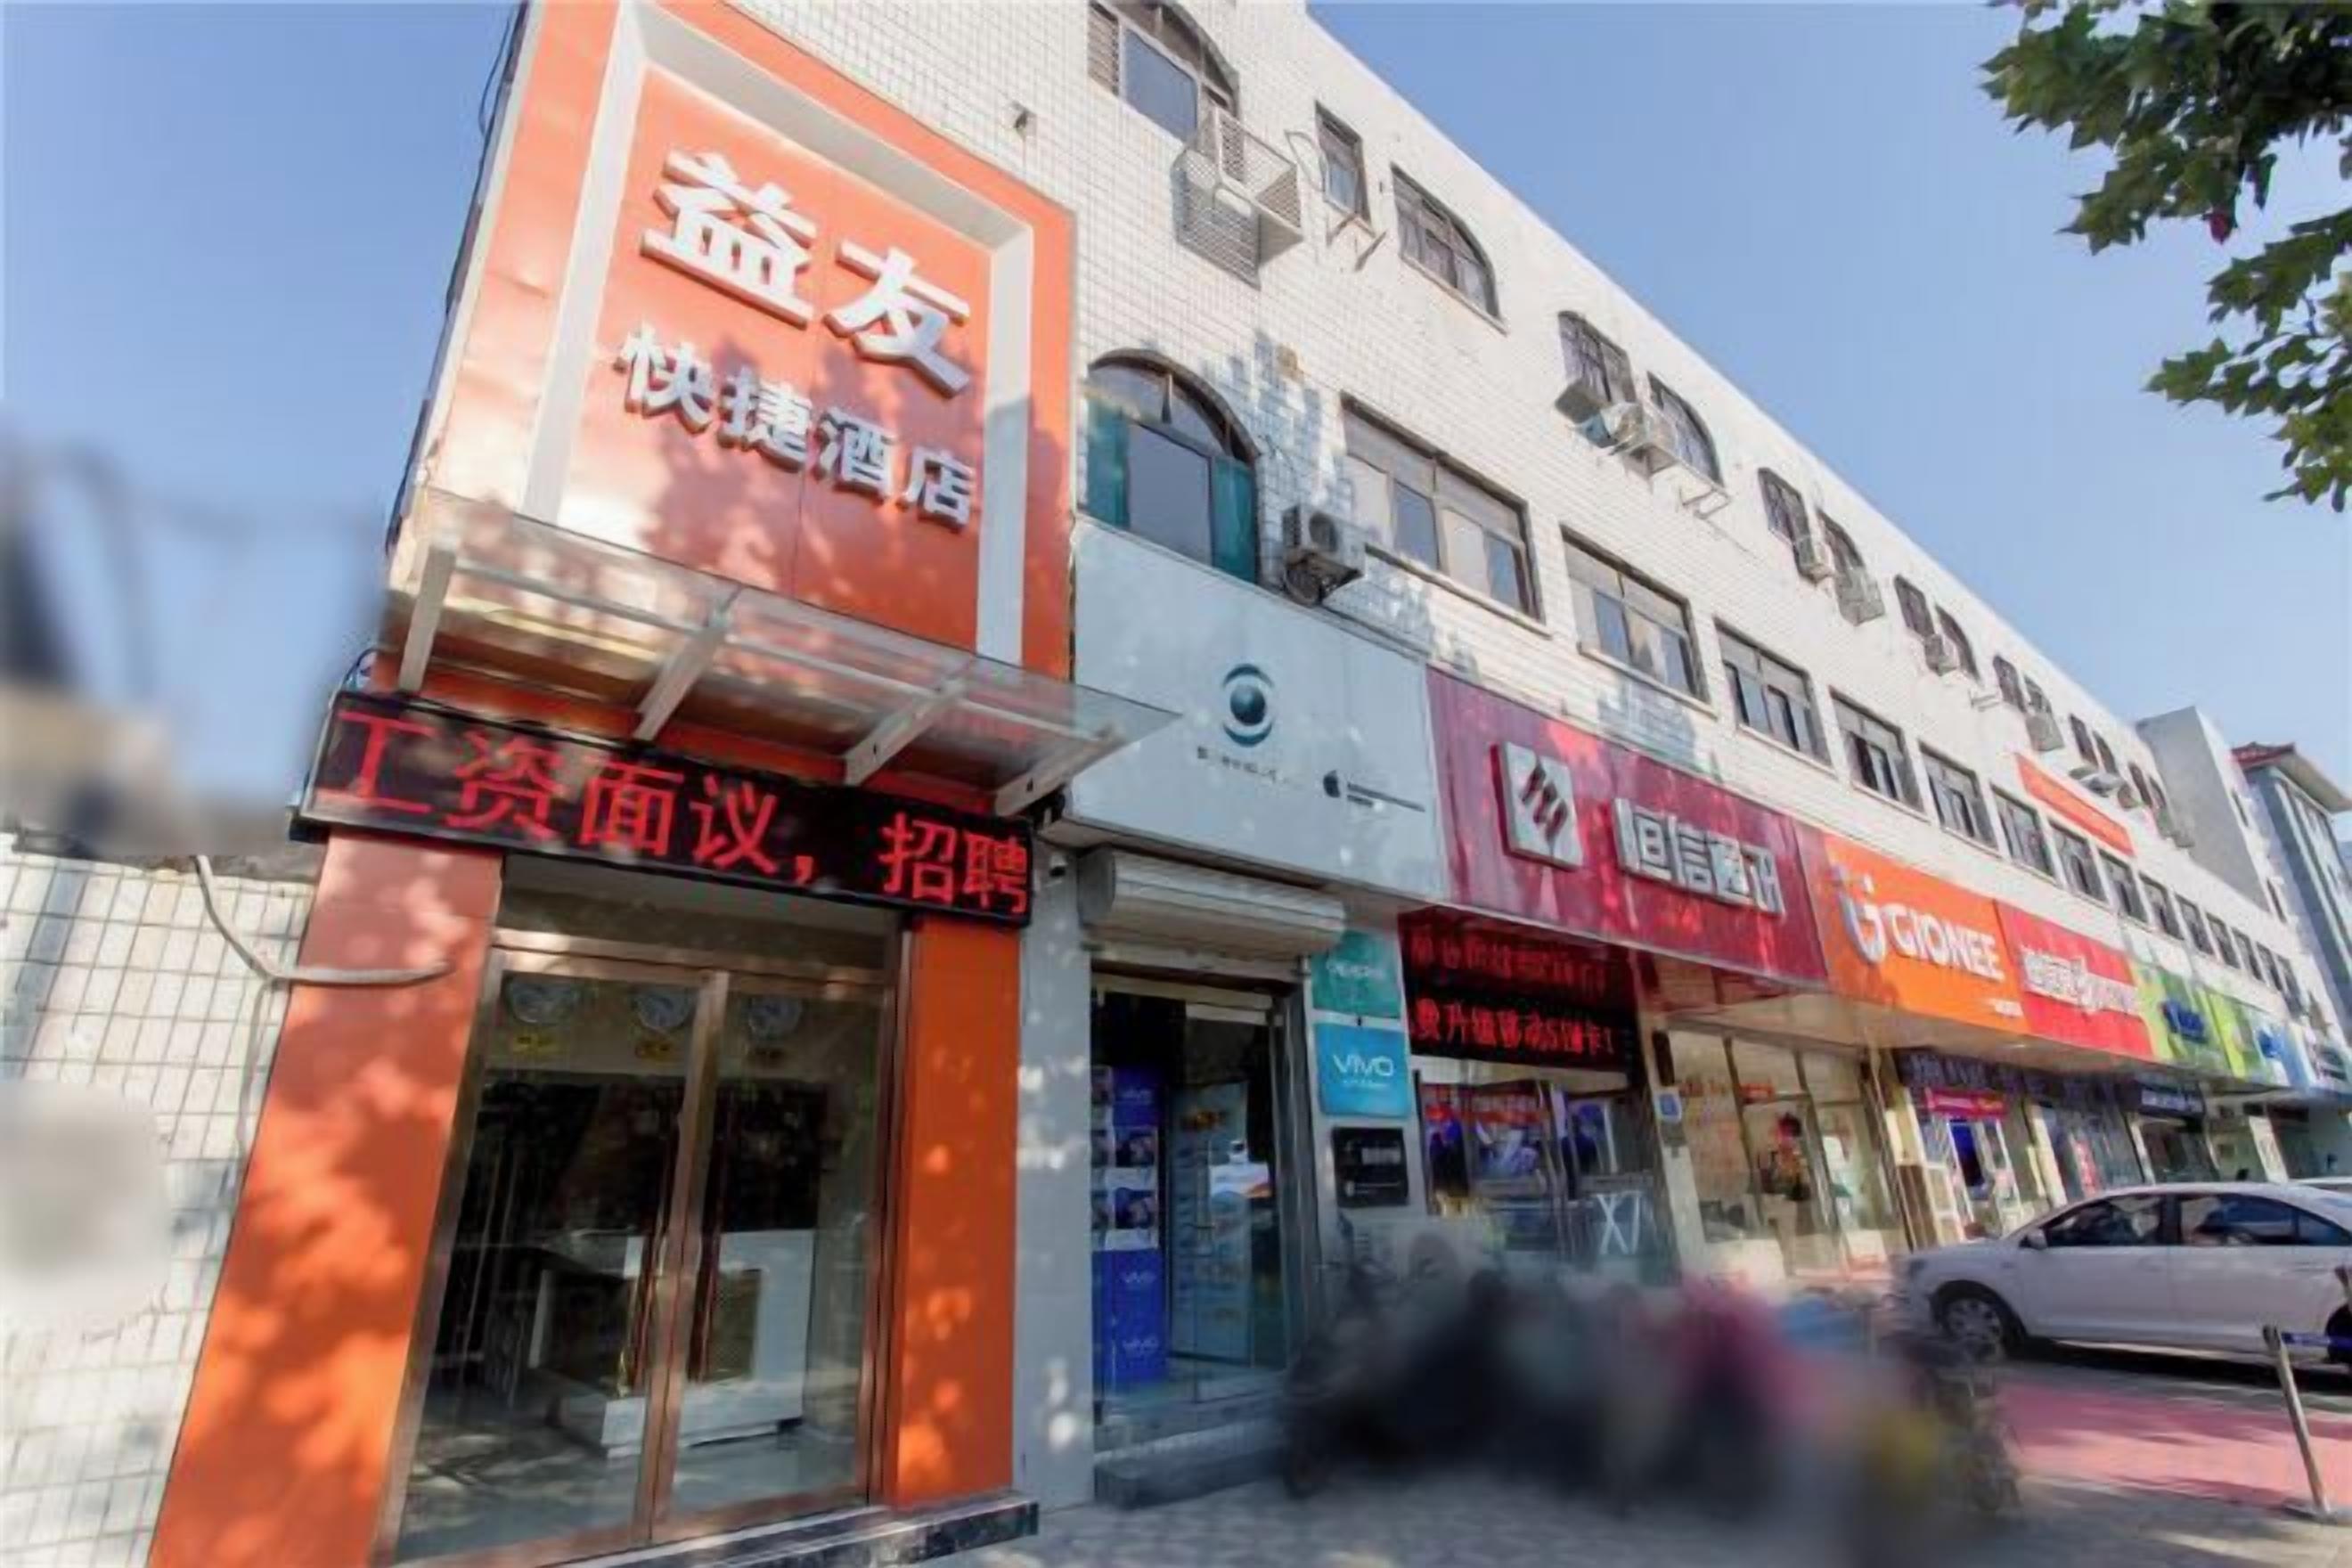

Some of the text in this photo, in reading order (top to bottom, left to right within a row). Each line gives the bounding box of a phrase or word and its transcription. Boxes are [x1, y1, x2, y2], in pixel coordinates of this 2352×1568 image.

[641, 149, 970, 399] 益友
[614, 320, 977, 535] 快捷酒店
[1882, 902, 2005, 983] GIONEE
